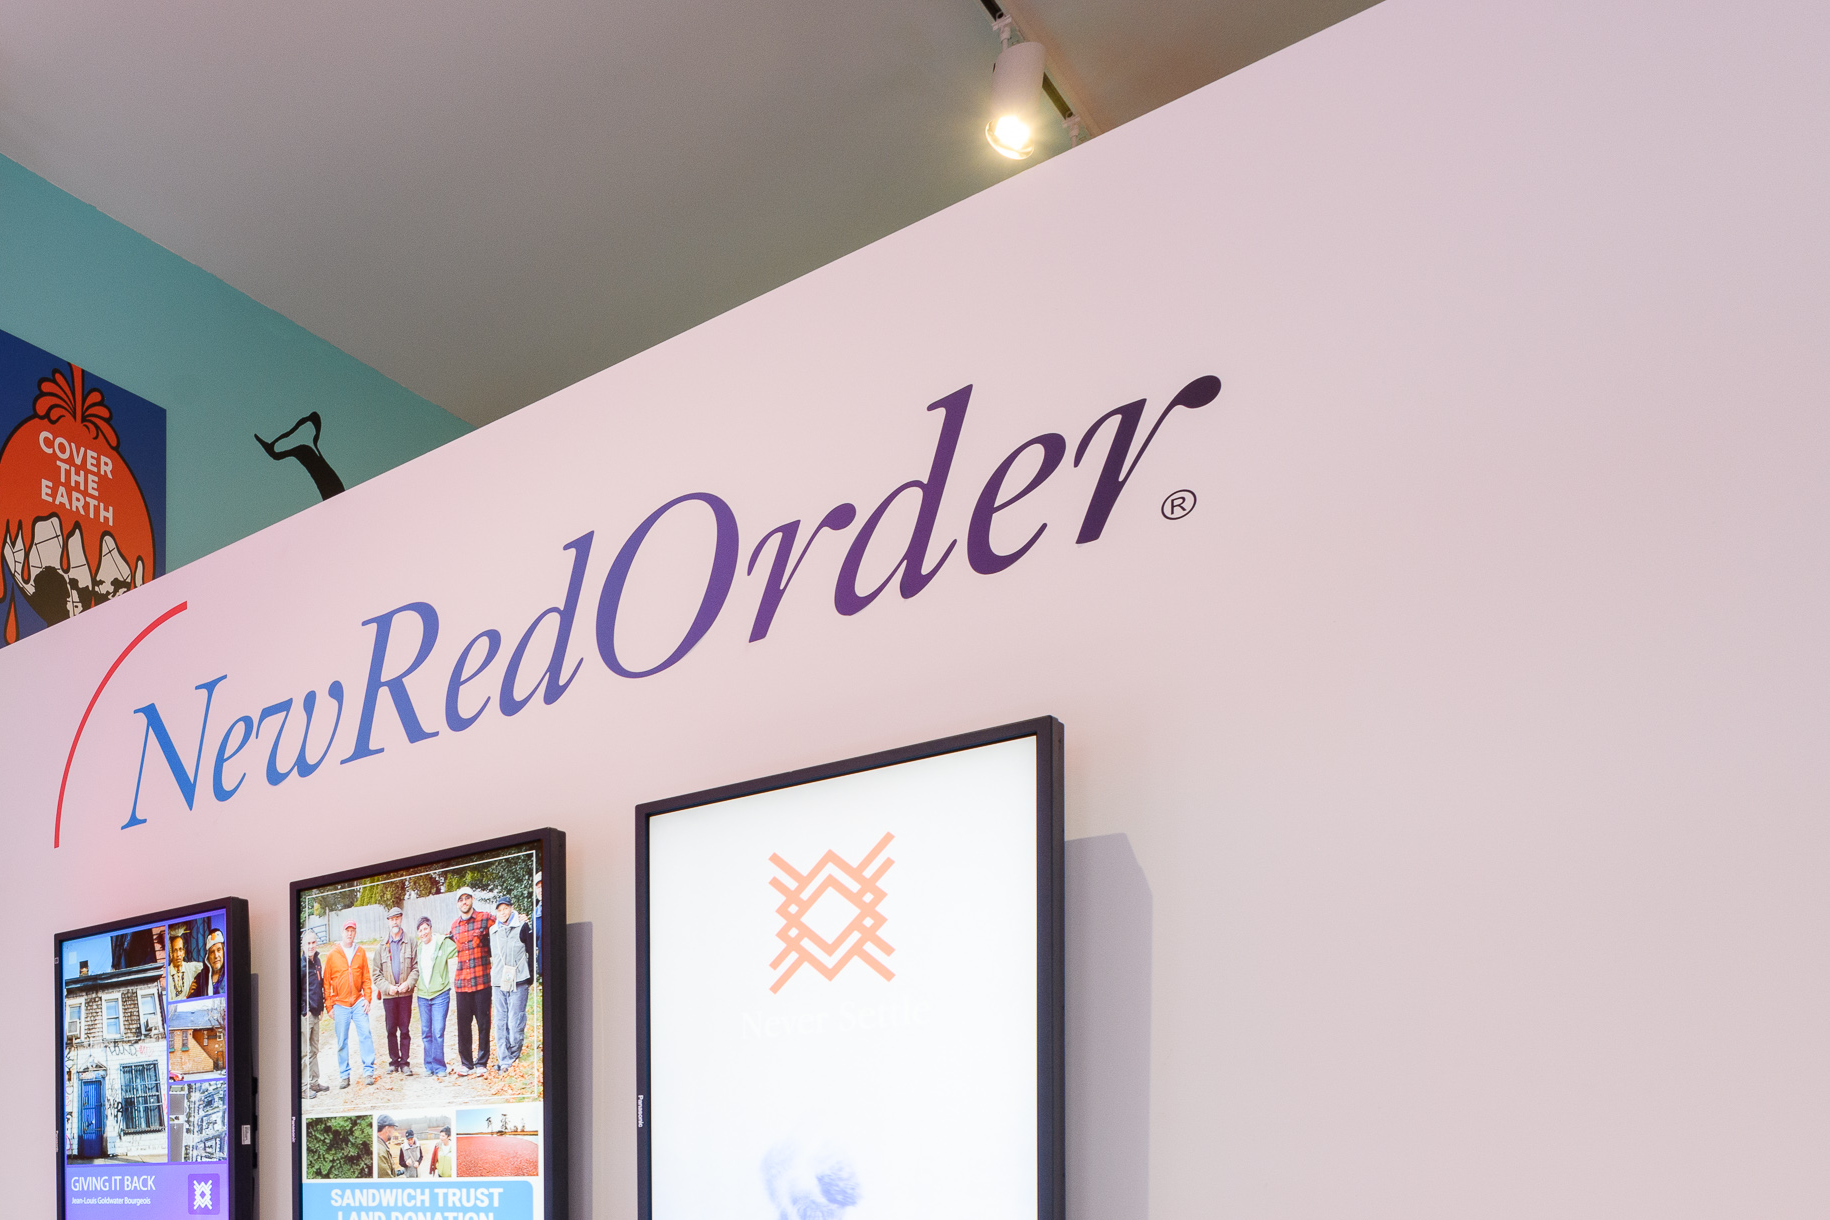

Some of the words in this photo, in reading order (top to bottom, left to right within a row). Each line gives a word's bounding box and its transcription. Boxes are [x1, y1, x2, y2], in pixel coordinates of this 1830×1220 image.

[39, 430, 114, 479] COVER
[56, 460, 99, 497] THE
[40, 478, 114, 527] EARTH
[739, 1012, 829, 1041] Never
[838, 994, 931, 1032] Settle
[71, 1176, 109, 1191] GIVING
[112, 1176, 122, 1191] IT
[124, 1175, 156, 1191] BACK
[72, 1197, 97, 1205] Jean-Louis
[97, 1197, 124, 1205] Goldwater
[124, 1197, 151, 1206] Bourgeois
[330, 1188, 430, 1207] SANDWICH
[434, 1188, 503, 1207] TRUST
